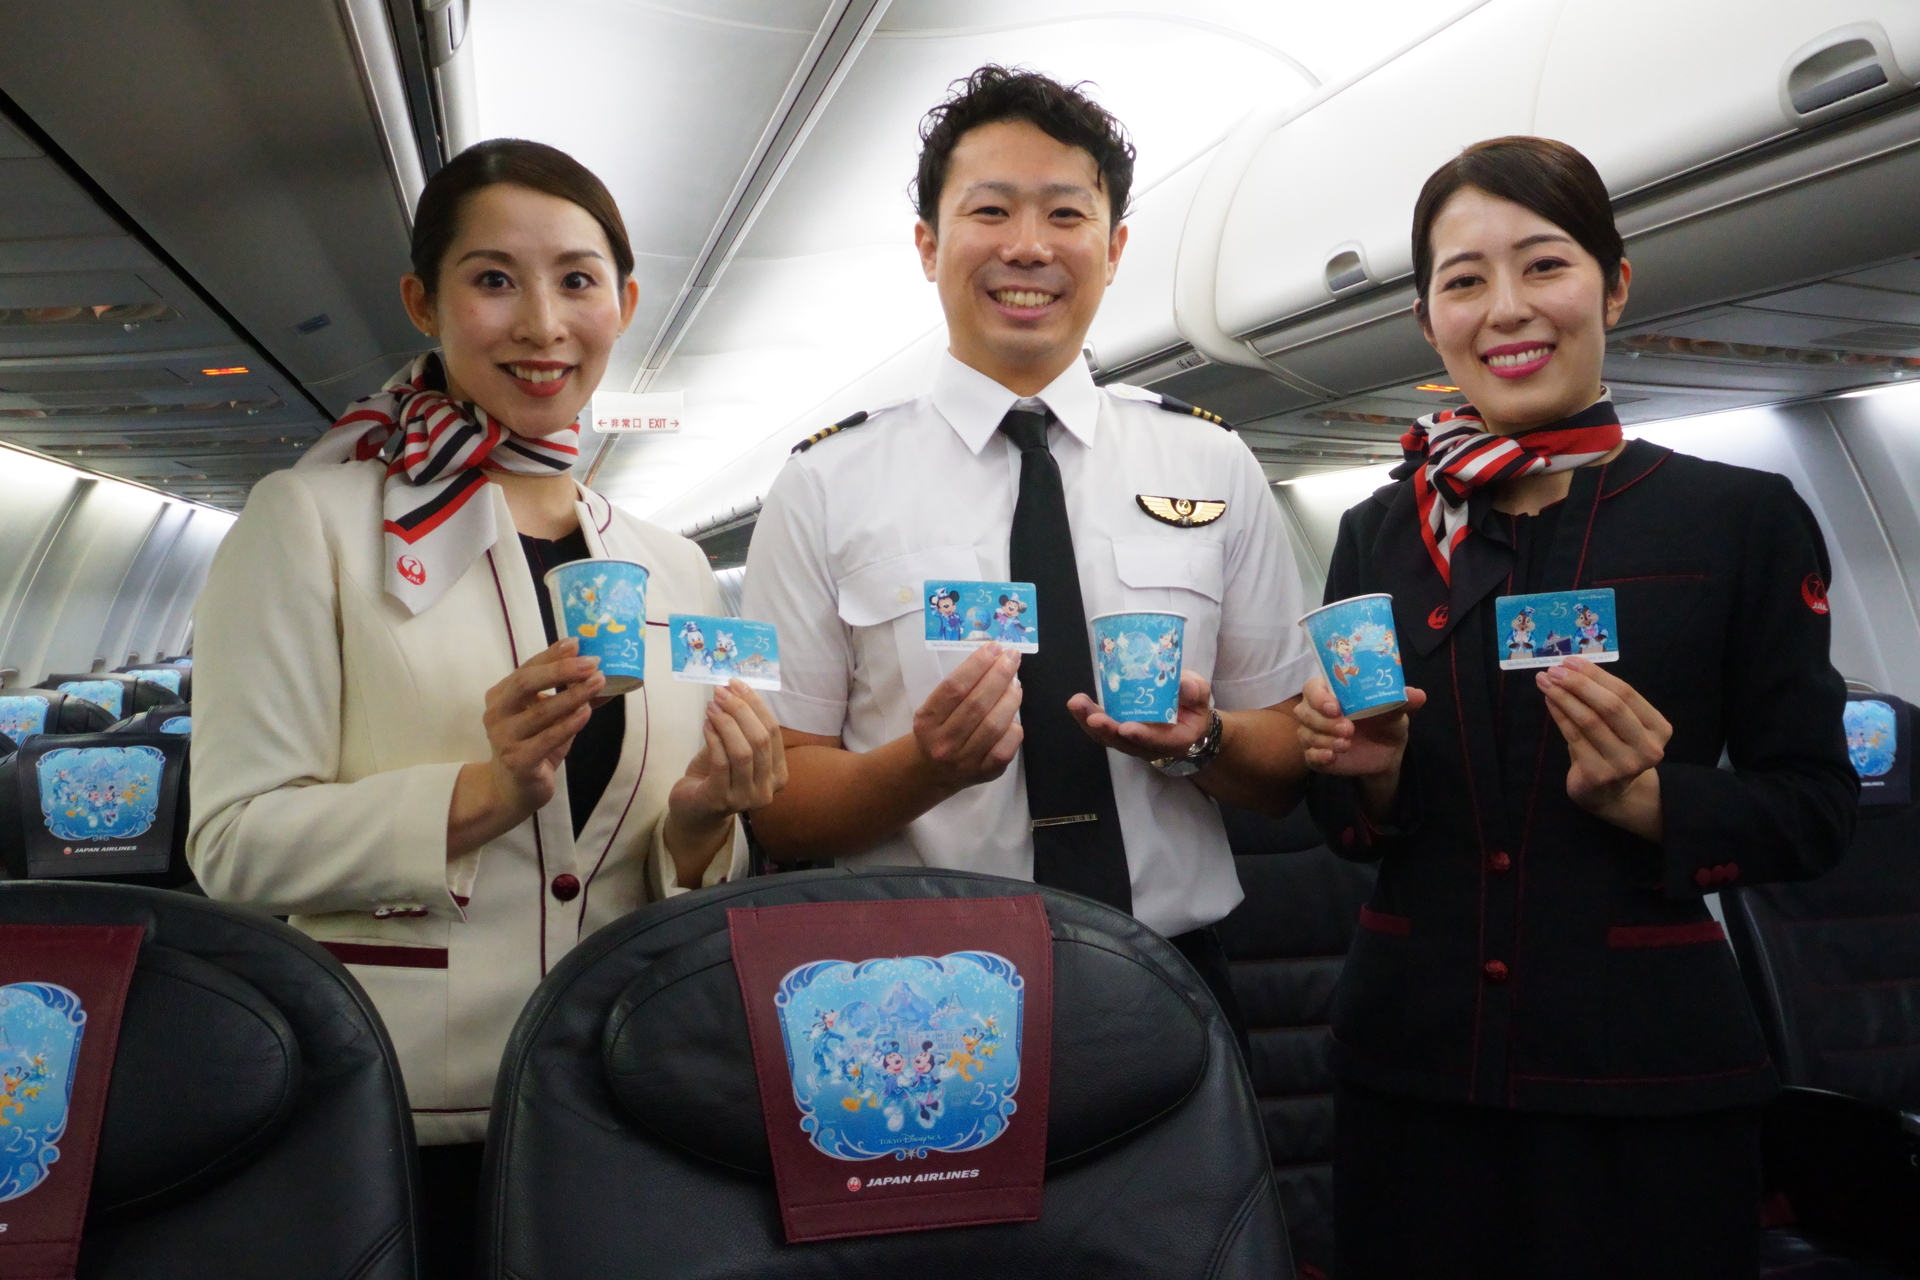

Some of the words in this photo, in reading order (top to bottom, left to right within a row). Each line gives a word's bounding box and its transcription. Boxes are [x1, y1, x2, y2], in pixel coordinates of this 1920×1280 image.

[611, 418, 641, 428] 非常口
[649, 418, 667, 428] EXIT
[976, 589, 993, 606] 25
[1550, 601, 1568, 618] 25
[1812, 602, 1828, 611] JAL
[621, 639, 639, 662] 25
[754, 635, 770, 652] 25
[1376, 668, 1394, 689] 25
[1134, 686, 1155, 708] 25
[131, 805, 146, 819] 25
[970, 1082, 998, 1110] 25
[4, 1126, 38, 1158] 25
[866, 1175, 911, 1187] JAPAN
[914, 1169, 980, 1183] AIRLINES
